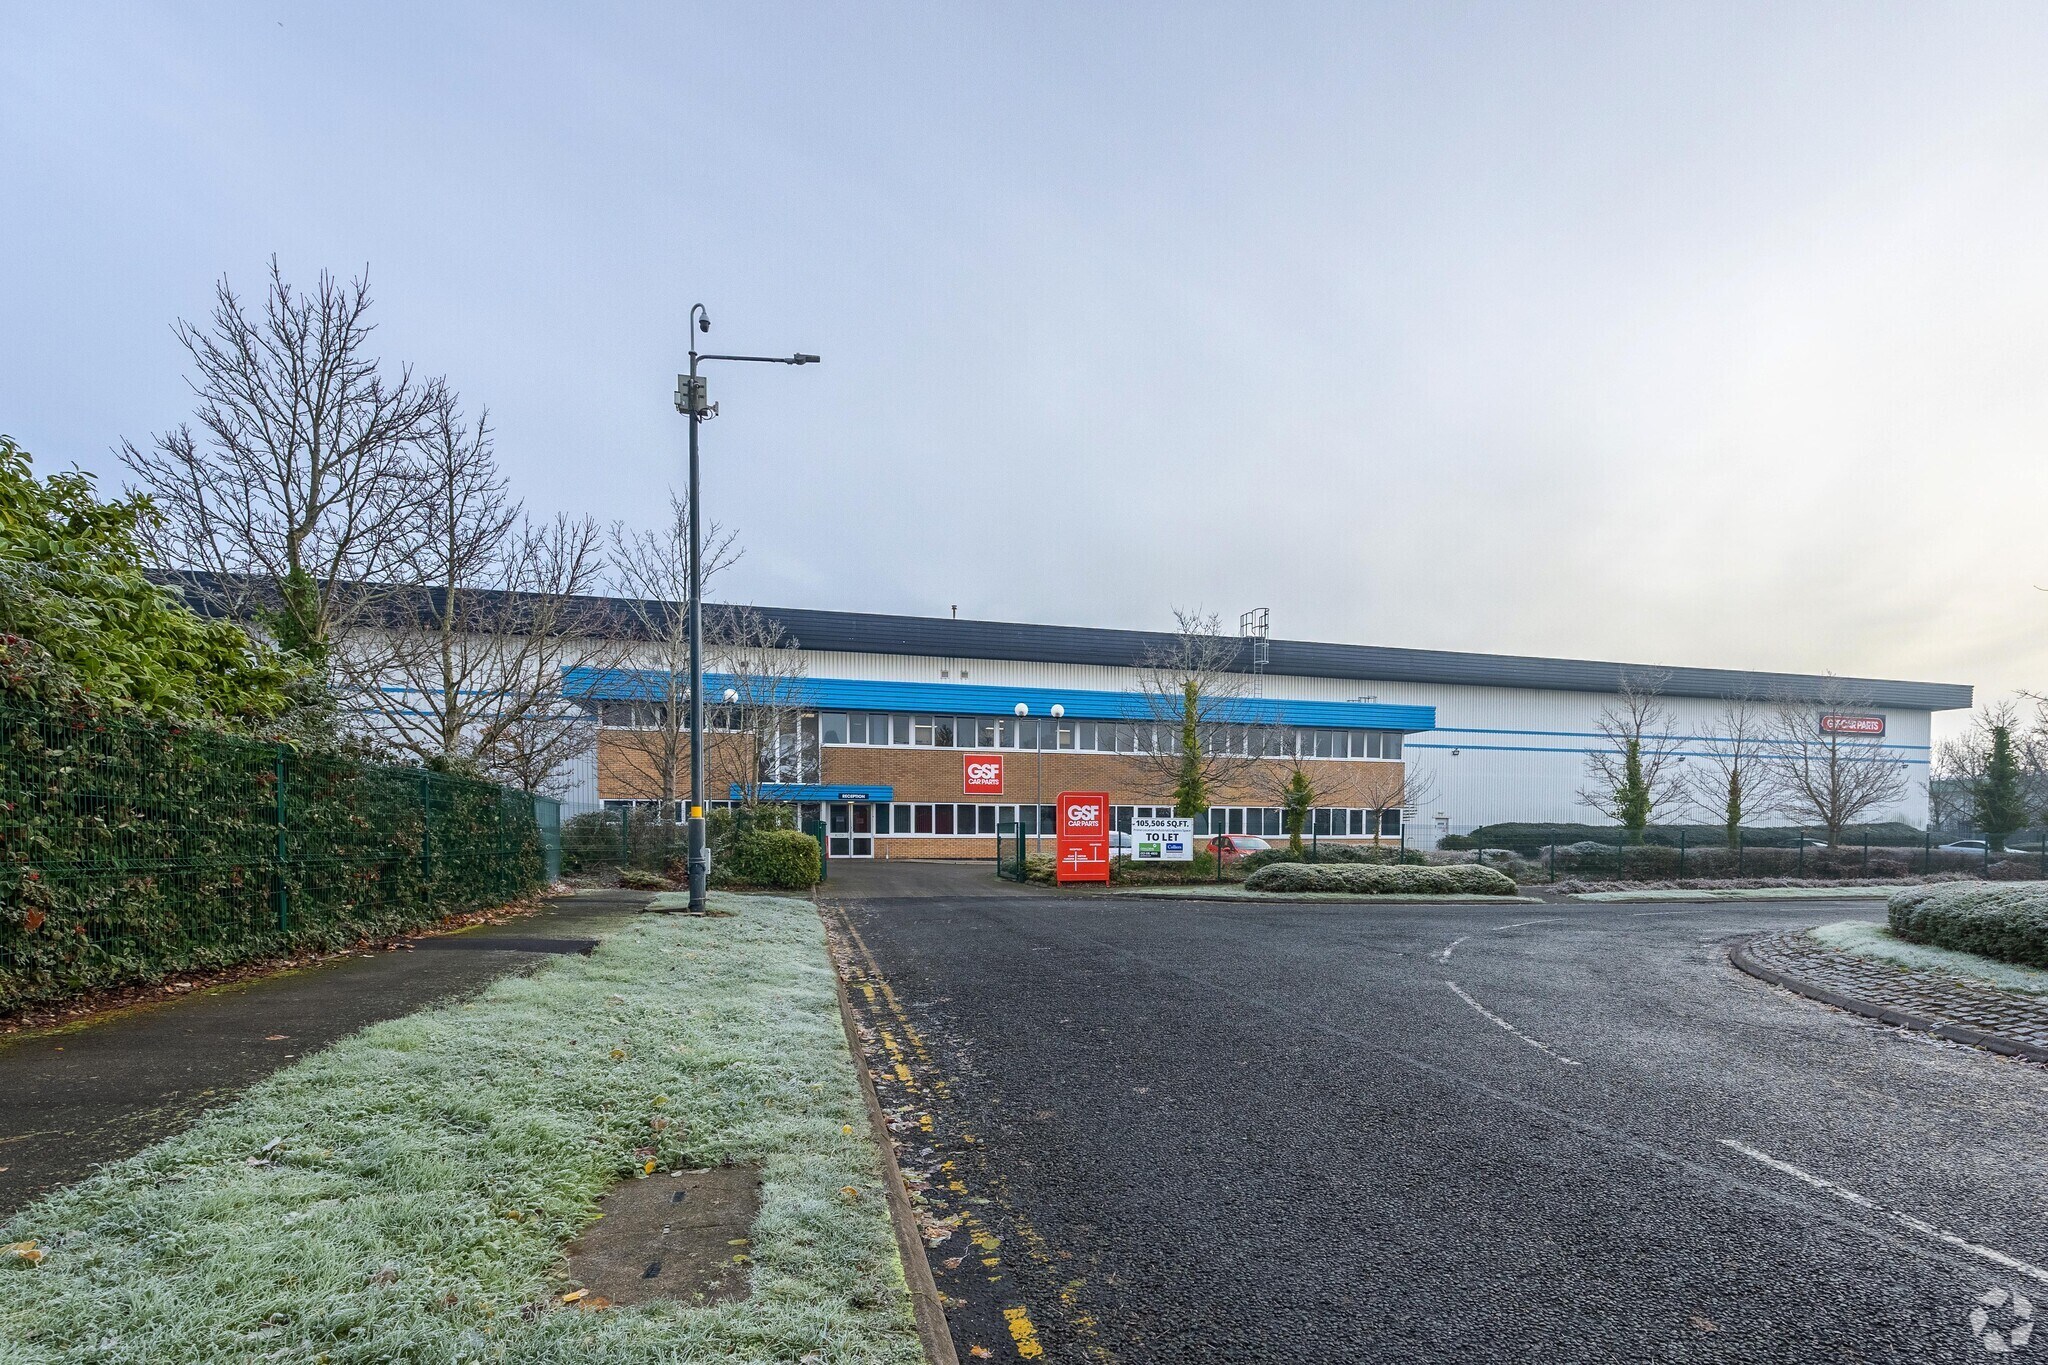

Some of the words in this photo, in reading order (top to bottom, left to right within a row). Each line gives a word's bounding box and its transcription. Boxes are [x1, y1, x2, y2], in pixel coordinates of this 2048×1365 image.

[1826, 719, 1842, 729] GF
[1857, 720, 1879, 731] PARTS
[967, 763, 999, 779] GSF
[1067, 804, 1099, 821] GSF
[1135, 819, 1165, 828] 105,506
[1166, 820, 1189, 828] SQ.FT.
[1146, 833, 1160, 841] TO
[1162, 833, 1179, 841] LET
